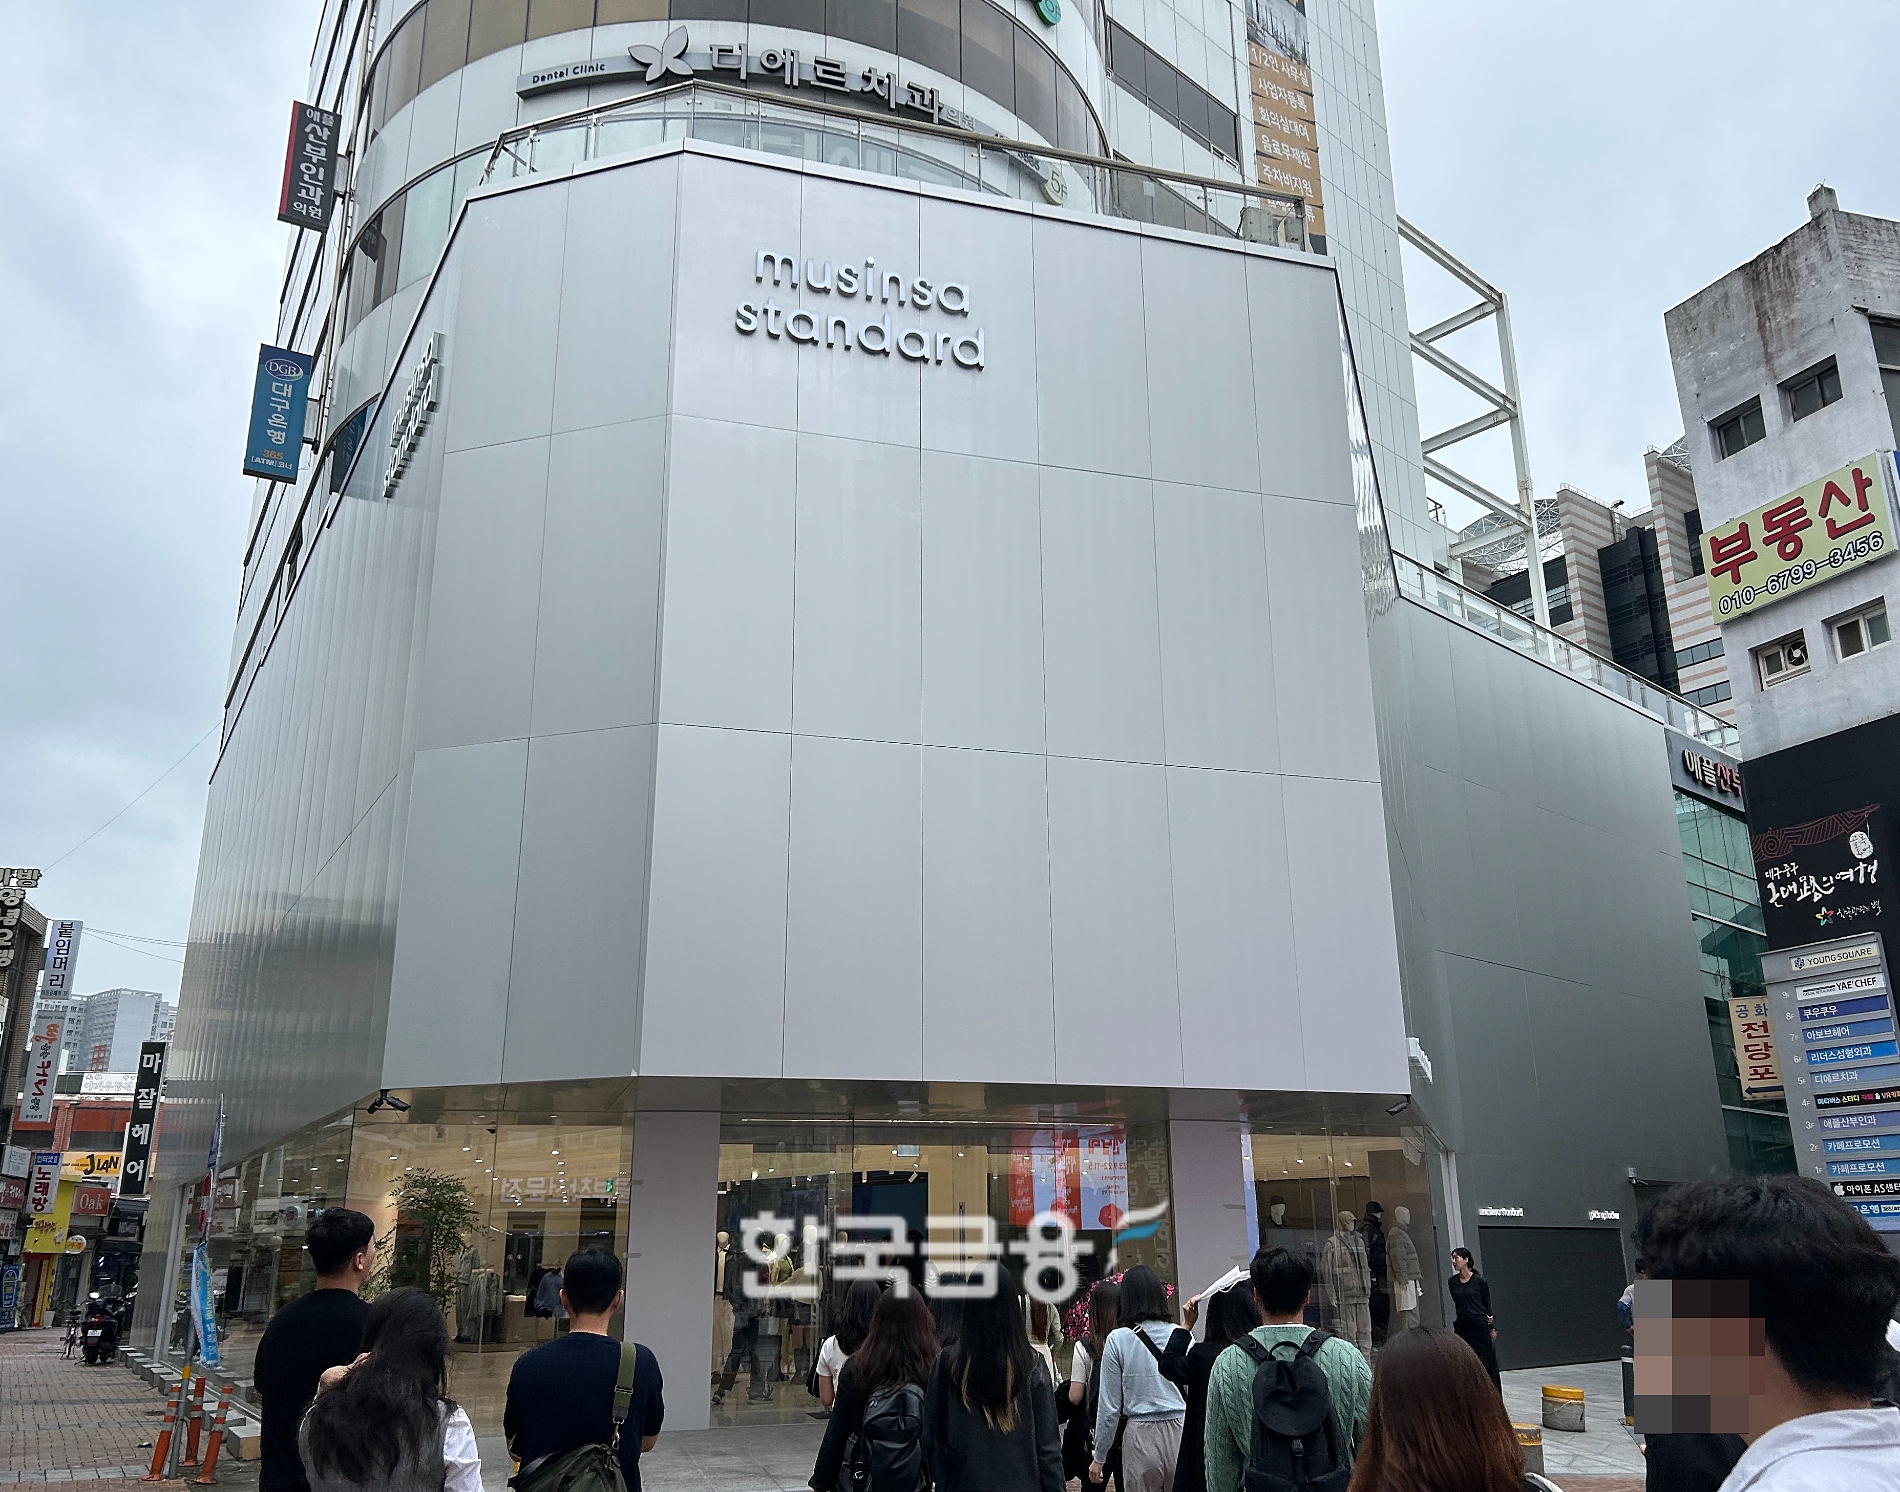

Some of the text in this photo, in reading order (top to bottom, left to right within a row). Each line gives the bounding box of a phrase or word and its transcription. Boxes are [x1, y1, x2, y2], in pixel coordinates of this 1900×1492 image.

[532, 62, 605, 84] Dental Clinic
[1281, 61, 1310, 88] 사무실
[710, 43, 976, 130] 디에르치과 의원
[1258, 77, 1308, 114] 사업자등록
[1258, 106, 1310, 142] 회의실대여
[1261, 134, 1312, 170] 음료무제한
[297, 123, 331, 206] 산부인과
[1262, 163, 1314, 198] 주차비지원
[293, 201, 322, 219] 의원
[756, 249, 970, 317] musinsa
[735, 296, 985, 371] standard
[269, 361, 297, 376] DGB
[267, 381, 293, 445] 대구은행
[262, 449, 283, 460] 365
[1709, 467, 1876, 585] 부동산
[1719, 530, 1884, 614] 010-6799-3456
[49, 921, 75, 988] 붙임머리
[1807, 947, 1872, 965] YOUNG SQUARE
[1854, 976, 1877, 988] CHEF
[1803, 1005, 1838, 1019] 쿠우쿠우
[1806, 1026, 1850, 1040] 아보브헤어
[1740, 1020, 1778, 1081] 전당포
[1811, 1045, 1872, 1062] 리더스성형외과
[1797, 1076, 1806, 1085] 5F
[1814, 1070, 1859, 1084] 디에르치과
[1801, 1099, 1811, 1107] 4F
[1842, 1094, 1860, 1103] 스터디
[126, 1052, 162, 1182] 마잘헤어
[1805, 1121, 1815, 1130] 3F
[1823, 1114, 1877, 1129] 애플산부인과
[1809, 1143, 1819, 1152] 2F
[1827, 1138, 1881, 1151] 카페프로모션
[1831, 1161, 1886, 1175] 카페프로모션
[31, 1166, 52, 1212] 노래방
[1846, 1184, 1872, 1194] 아이폰
[80, 1193, 104, 1210] Oak
